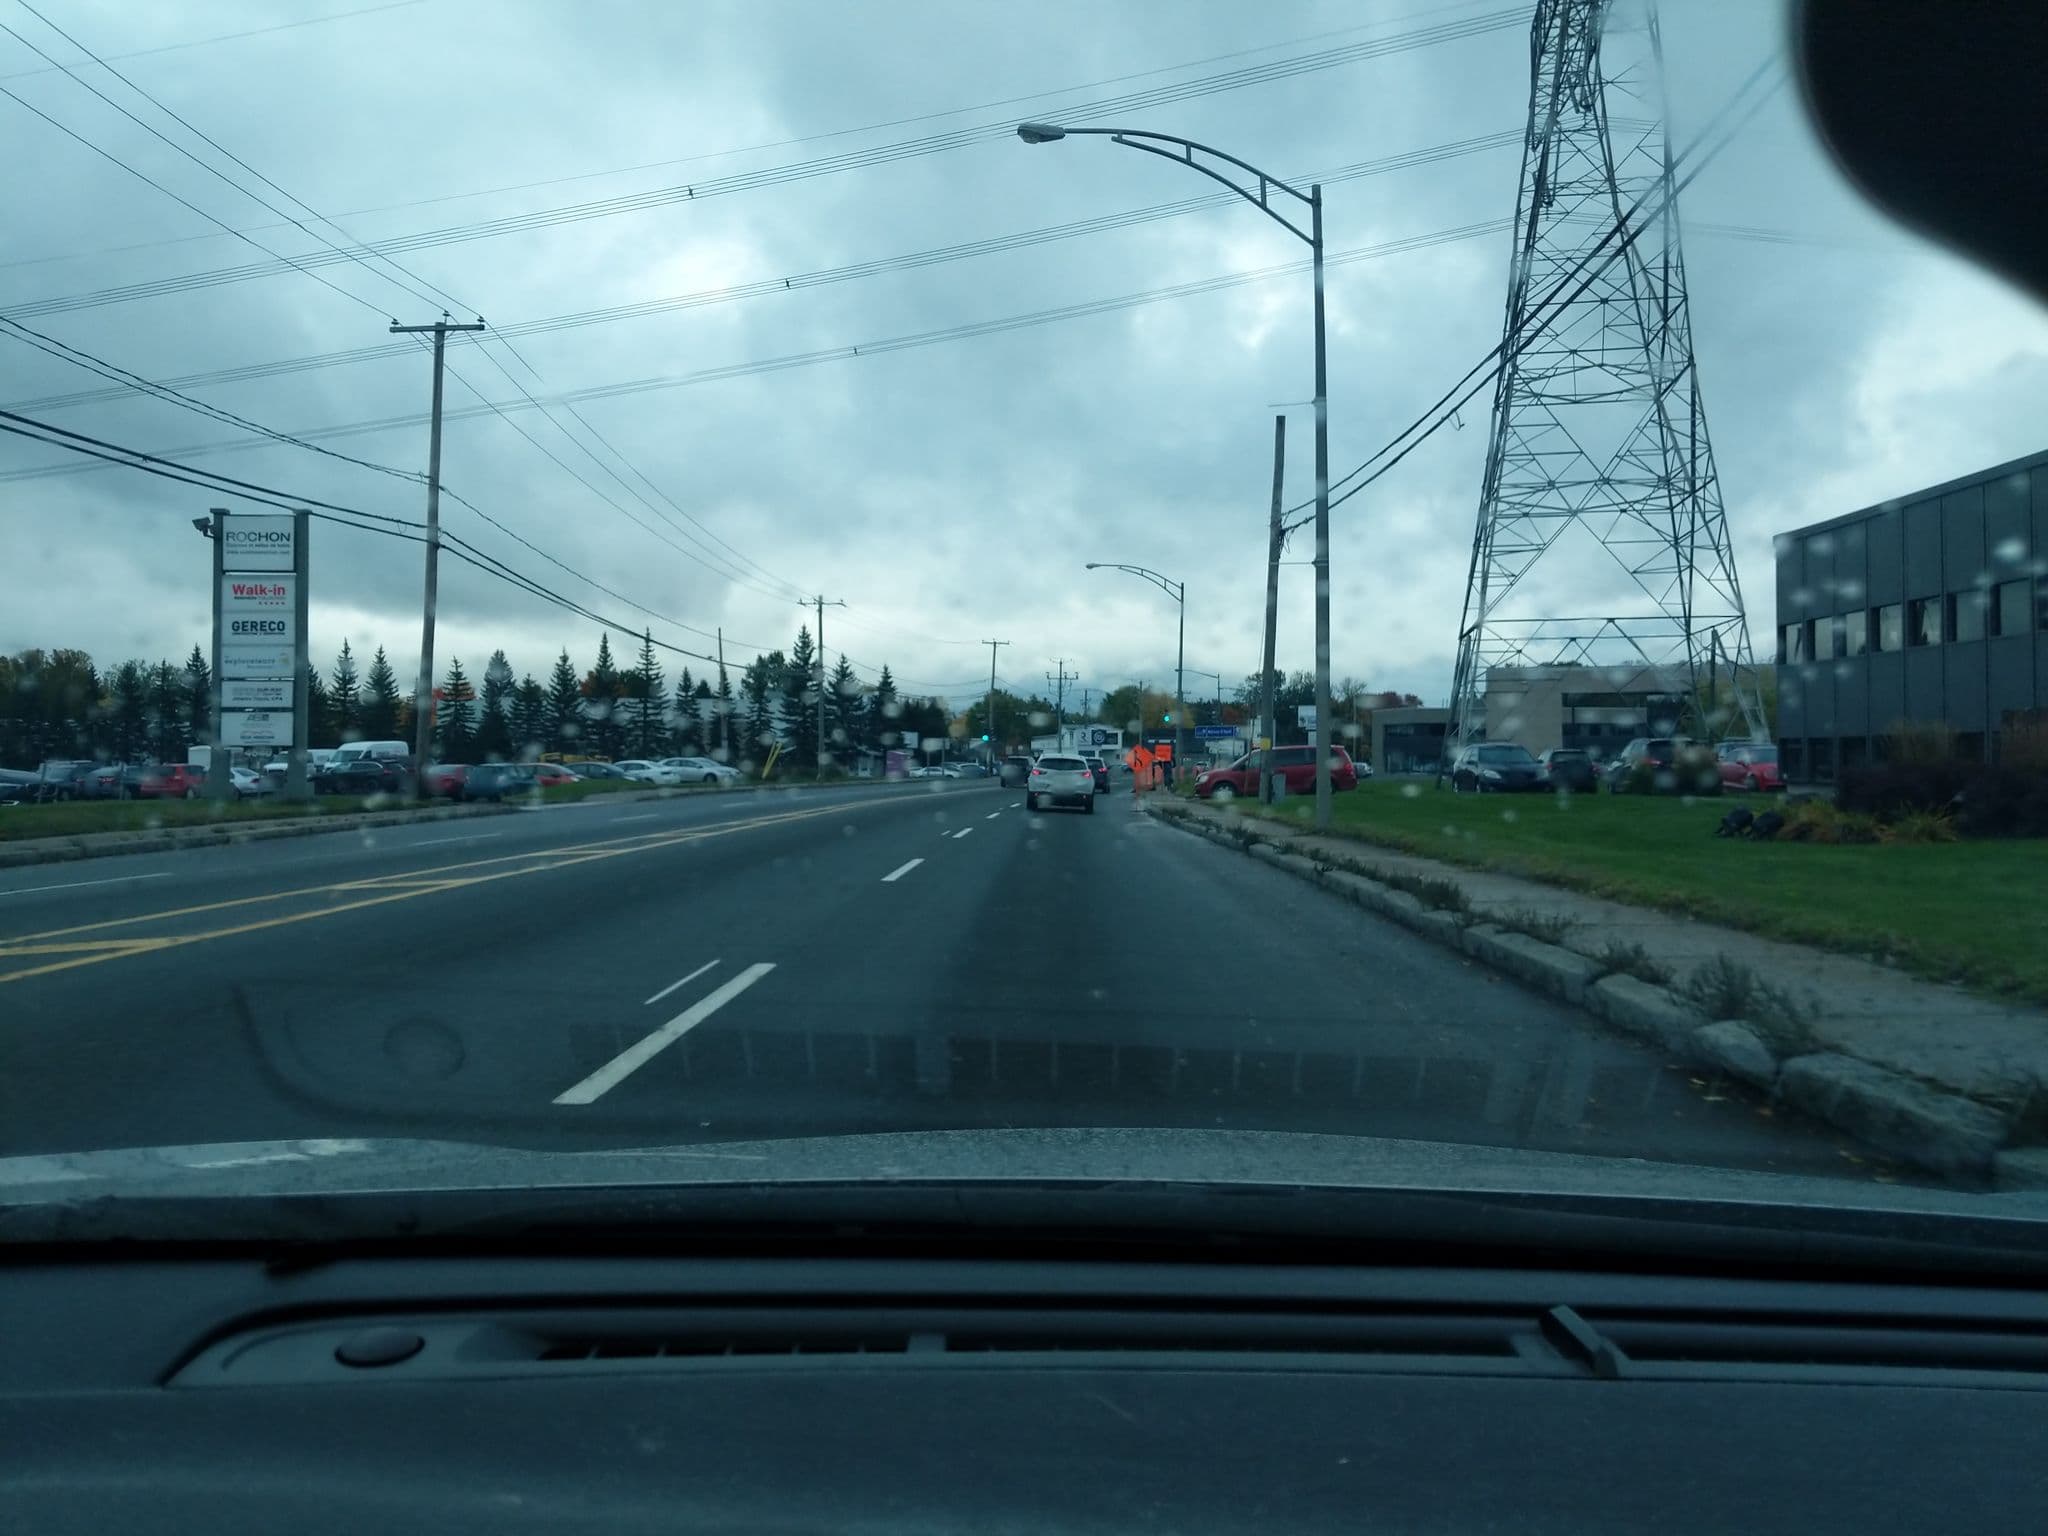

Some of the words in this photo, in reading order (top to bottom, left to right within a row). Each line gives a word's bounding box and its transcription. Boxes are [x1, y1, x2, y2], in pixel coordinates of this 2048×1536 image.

[225, 531, 291, 543] ROCHON
[232, 583, 286, 596] Walk-in
[231, 620, 286, 632] GERECO
